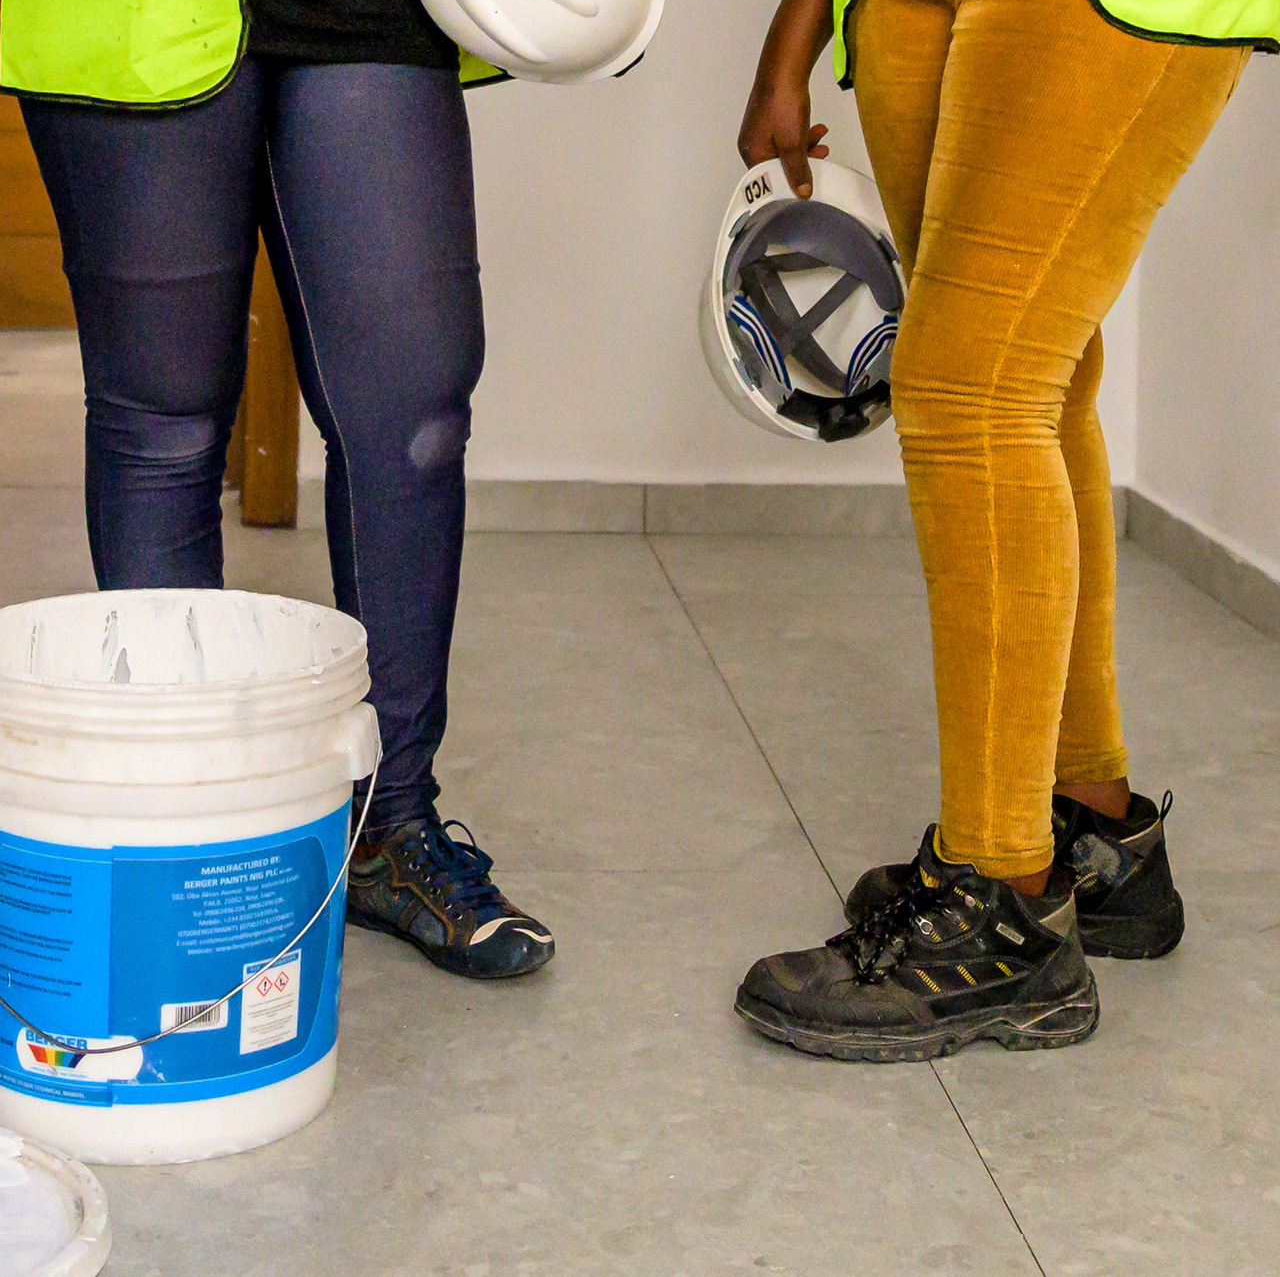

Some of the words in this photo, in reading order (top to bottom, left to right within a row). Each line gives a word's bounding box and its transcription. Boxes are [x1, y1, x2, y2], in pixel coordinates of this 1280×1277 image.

[744, 176, 771, 204] YCD
[201, 858, 269, 875] MANUFACTURED
[270, 856, 281, 865] BY:
[184, 878, 218, 889] BERGER
[220, 874, 248, 886] PAINTS
[249, 871, 264, 881] NIG
[265, 868, 279, 878] PLC
